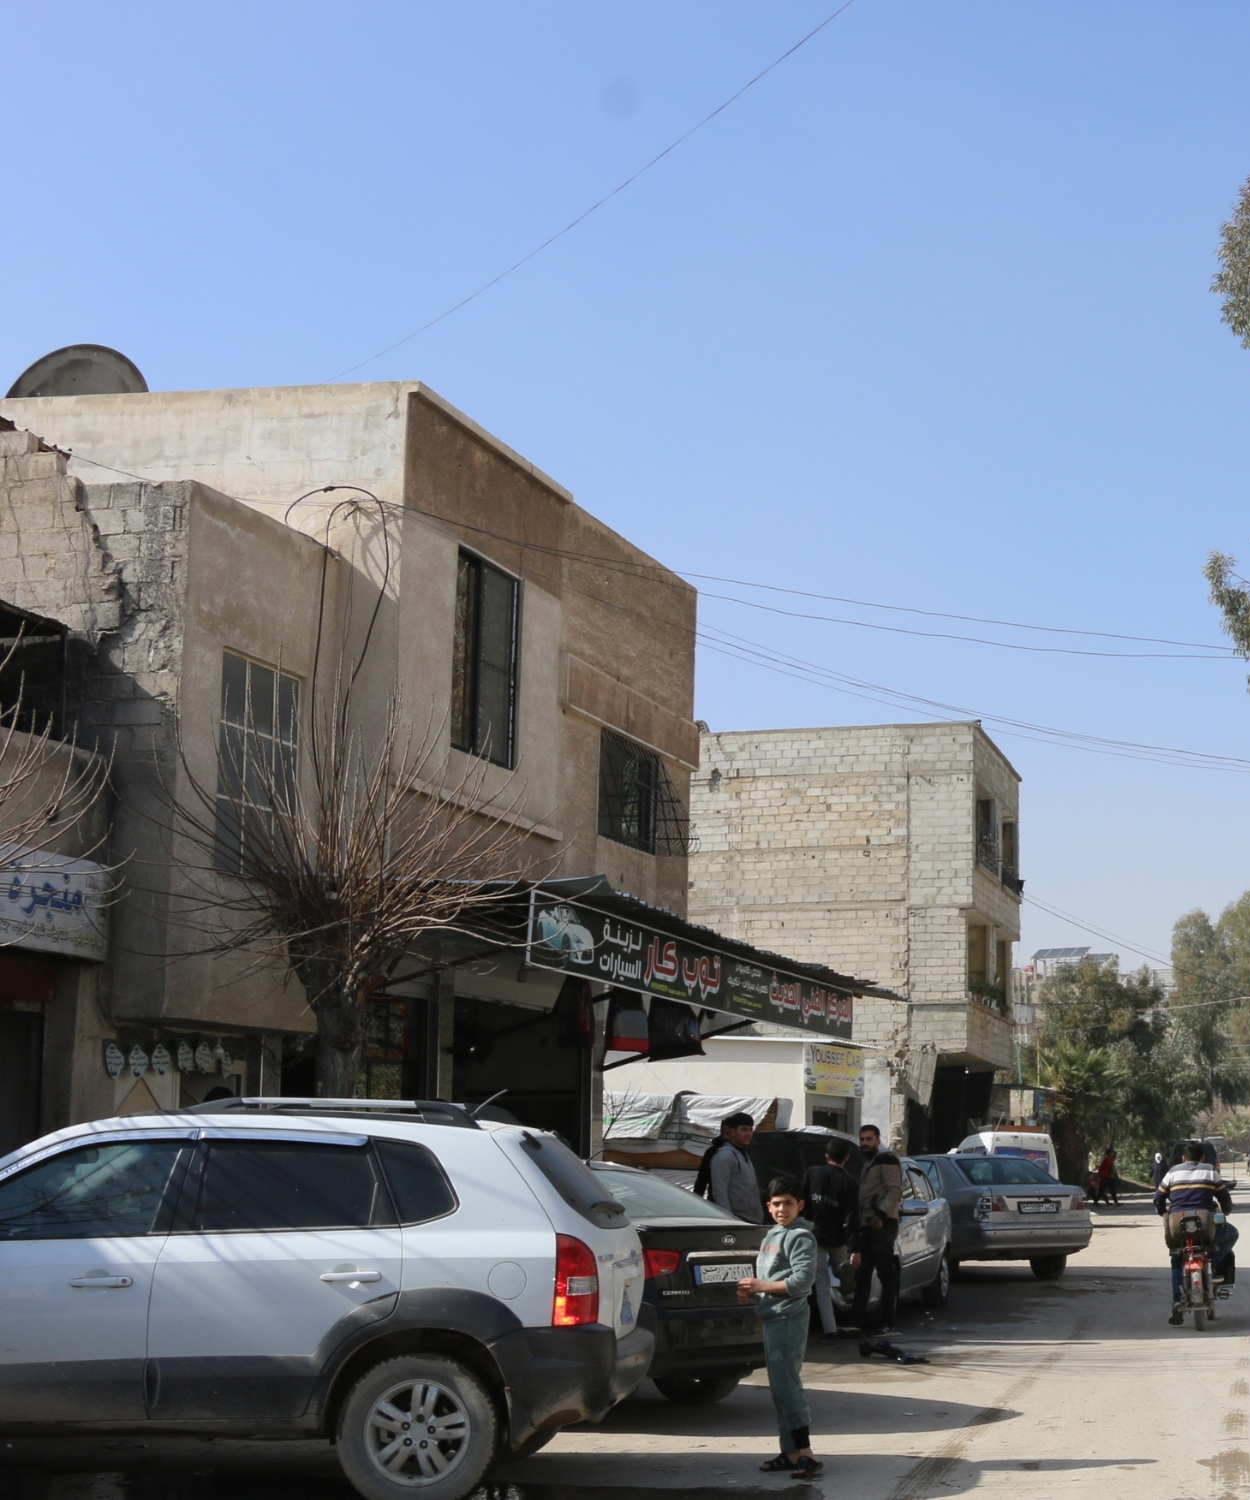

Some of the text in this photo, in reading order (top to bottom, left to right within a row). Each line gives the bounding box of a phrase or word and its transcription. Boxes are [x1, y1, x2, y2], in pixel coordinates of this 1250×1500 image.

[8, 860, 83, 920] منجرة
[602, 918, 642, 954] لزينة
[600, 952, 642, 981] السيارات
[643, 936, 722, 1001] توب كار
[769, 971, 801, 1014] الحديث
[826, 992, 852, 1027] المركز
[809, 1044, 845, 1066] YOUSSEF
